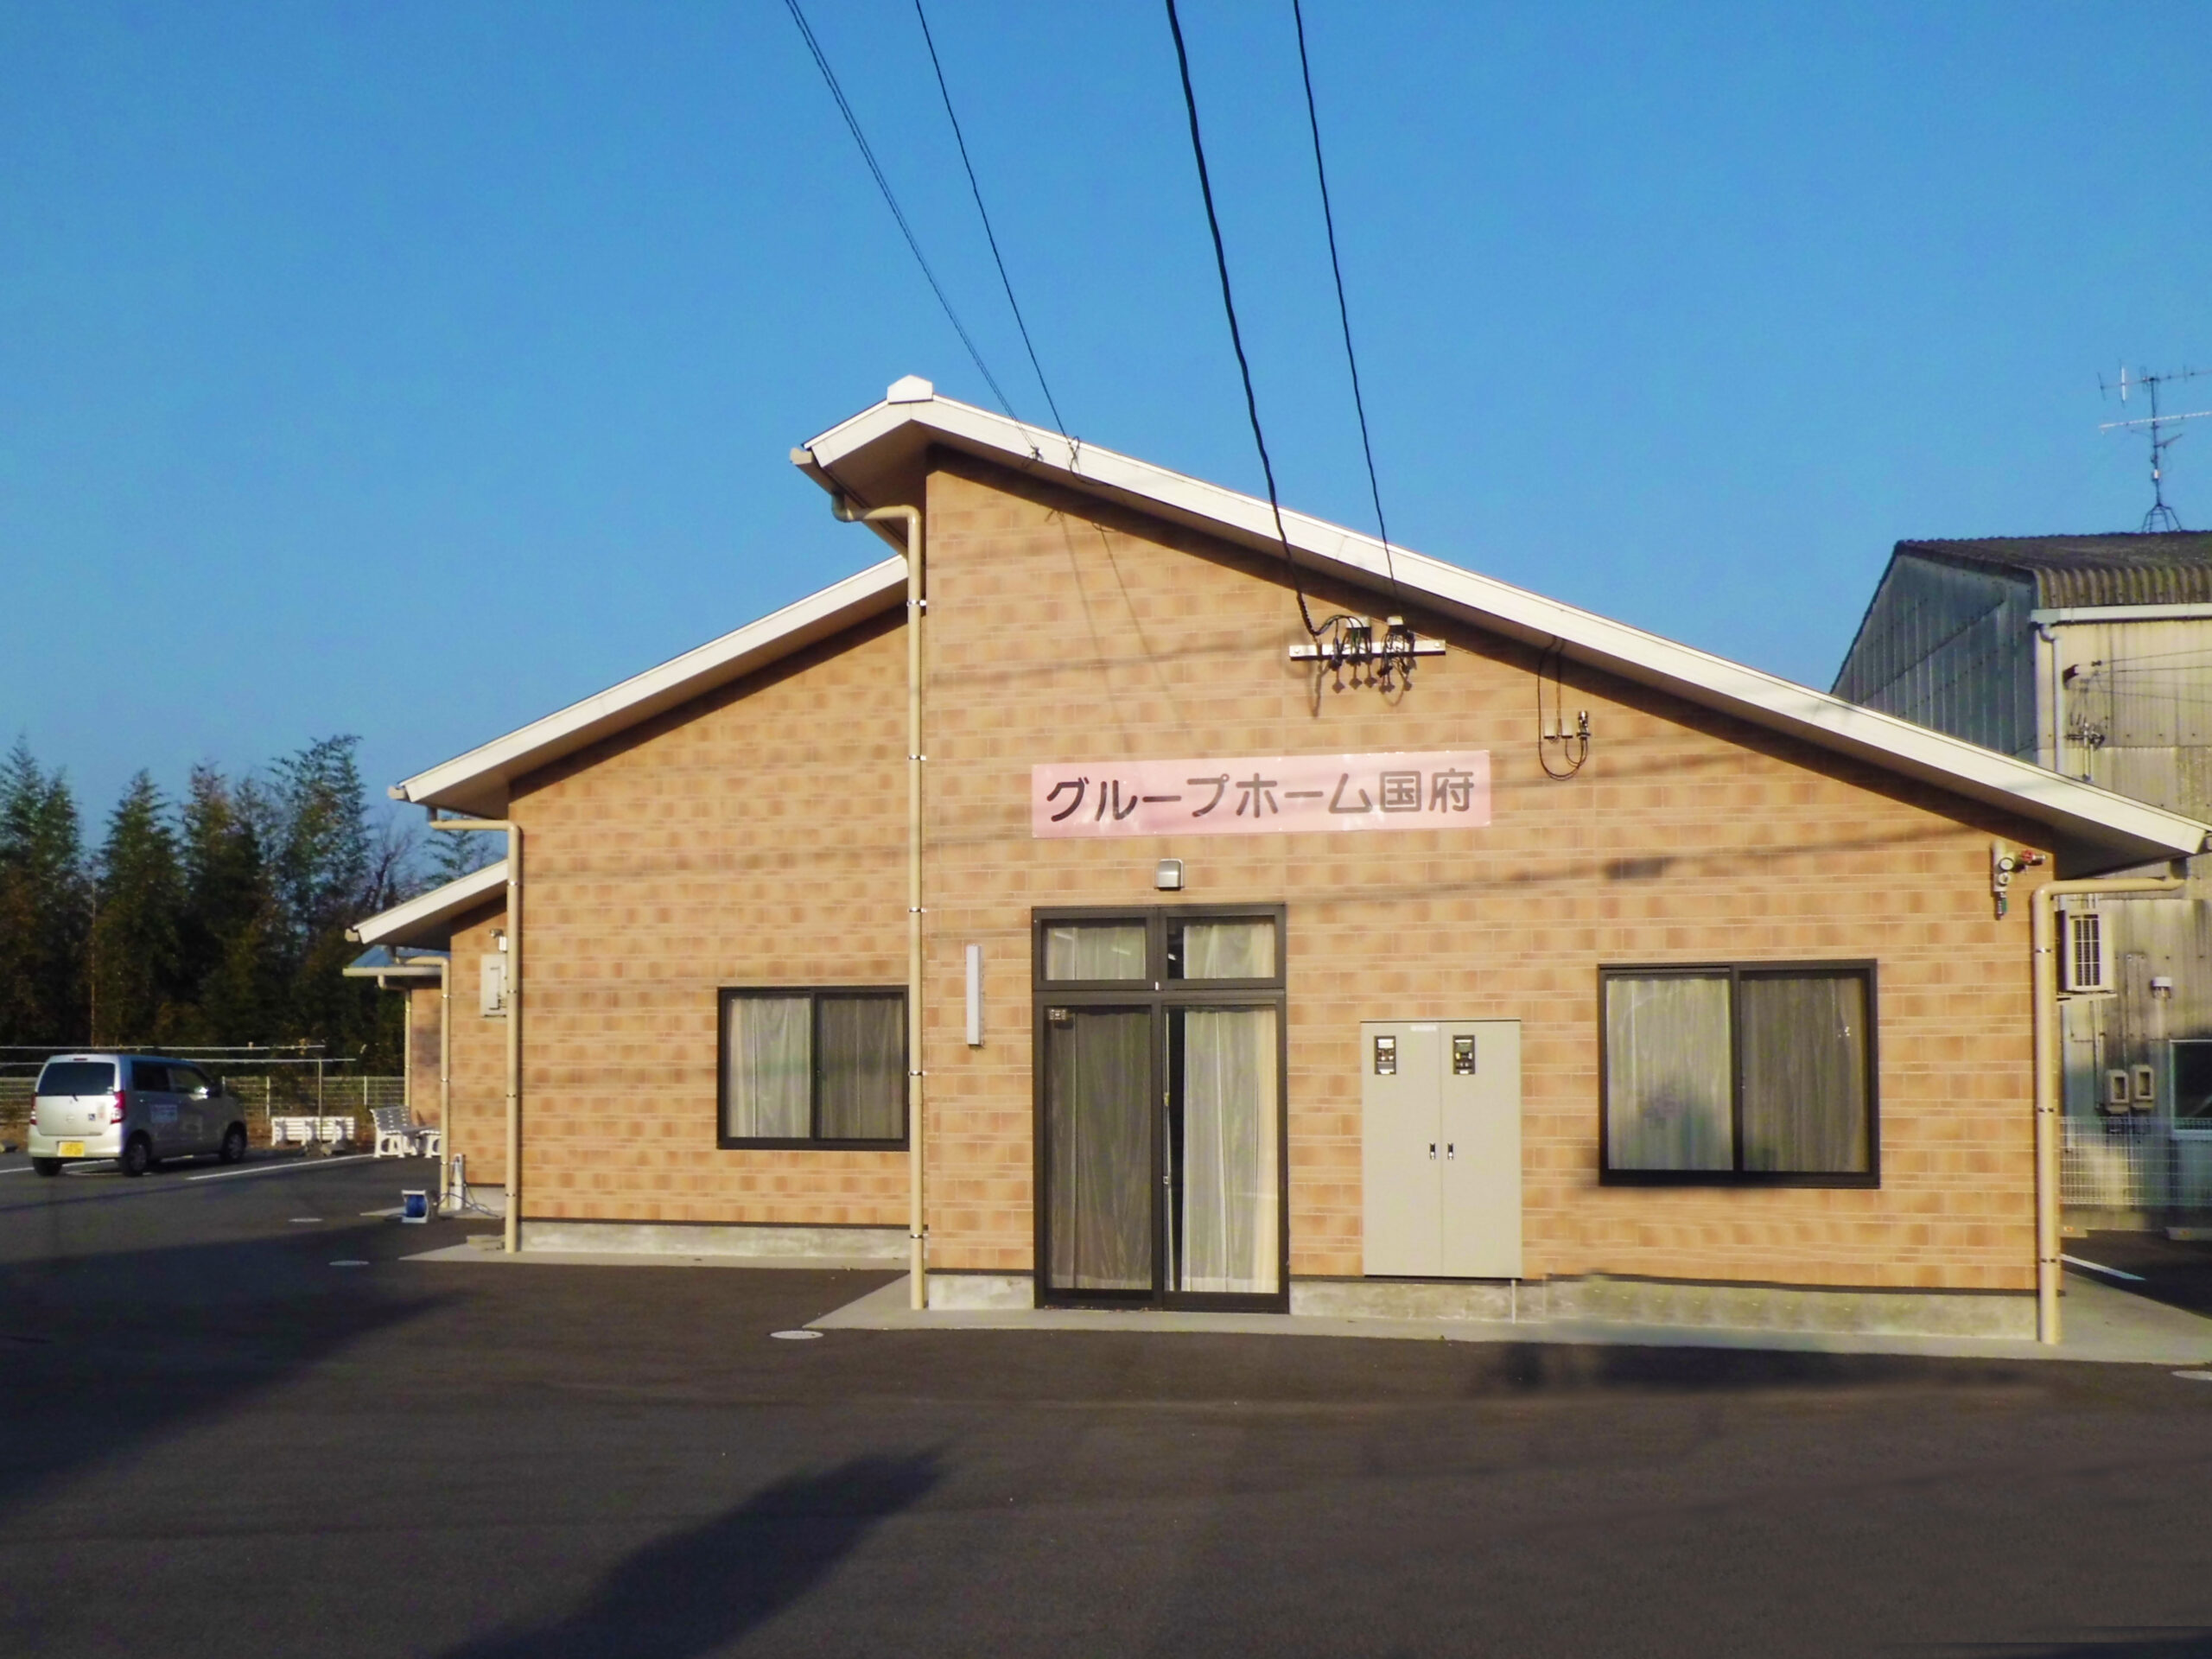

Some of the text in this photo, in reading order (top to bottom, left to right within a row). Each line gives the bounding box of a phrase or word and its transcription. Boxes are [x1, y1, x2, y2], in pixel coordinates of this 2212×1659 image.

[1046, 767, 1475, 822] グループホーム国府
